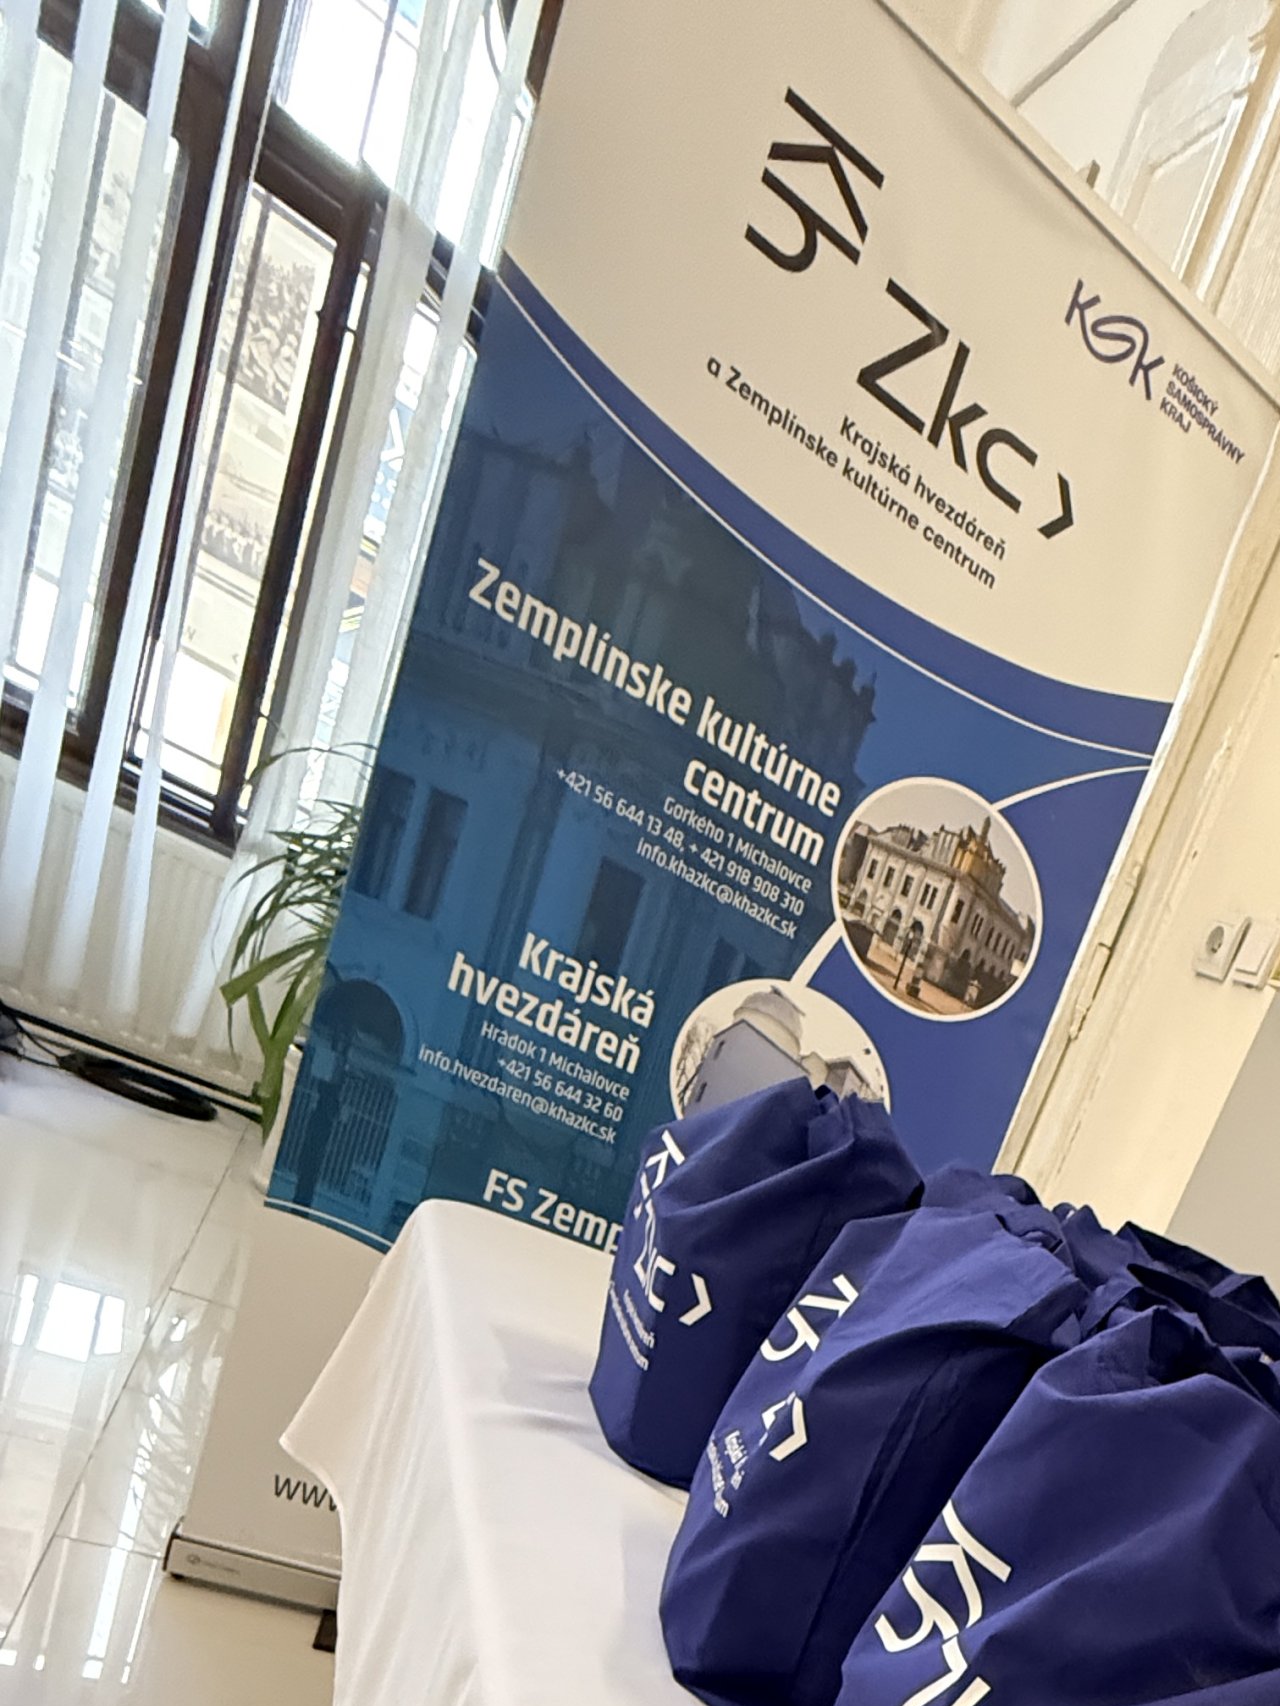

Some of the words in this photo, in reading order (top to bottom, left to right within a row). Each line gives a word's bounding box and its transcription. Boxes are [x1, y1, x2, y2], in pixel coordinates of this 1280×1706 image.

[1160, 397, 1192, 433] KRAJ
[1166, 381, 1245, 464] SAMOSPRÁVNY
[1172, 363, 1218, 416] KOŠICKÝ
[706, 356, 721, 378] a
[725, 366, 838, 468] Zemplínske
[841, 458, 919, 531] kultúrne
[922, 525, 996, 589] centrum
[840, 415, 911, 485] Krajská
[914, 474, 1007, 561] hvezdáreň
[469, 557, 692, 726] Zemplínske
[696, 696, 841, 817] kultúrne
[557, 767, 592, 797] +421
[594, 785, 614, 809] 56
[615, 798, 645, 827] 644
[646, 814, 663, 835] 13
[663, 827, 685, 853] 48,
[700, 849, 724, 872] 421
[726, 861, 751, 886] 918
[753, 876, 779, 902] 908
[781, 891, 805, 916] 310
[663, 796, 725, 844] Gorkého
[727, 832, 736, 848] 1
[735, 838, 812, 894] Michalovce
[683, 759, 825, 866] centrum
[636, 837, 799, 940] info.khazkc@khazkc.sk
[447, 951, 641, 1074] hvezdáreň
[518, 931, 655, 1029] Krajská
[418, 1043, 617, 1145] info.hvezdaren@khazkc.sk
[497, 1057, 531, 1081] +421
[534, 1072, 553, 1091] 56
[555, 1080, 582, 1104] 644
[583, 1093, 602, 1114] 32
[603, 1102, 624, 1123] 60
[539, 1046, 548, 1063] 1
[550, 1051, 630, 1100] Michalovce
[483, 1168, 528, 1212] FS
